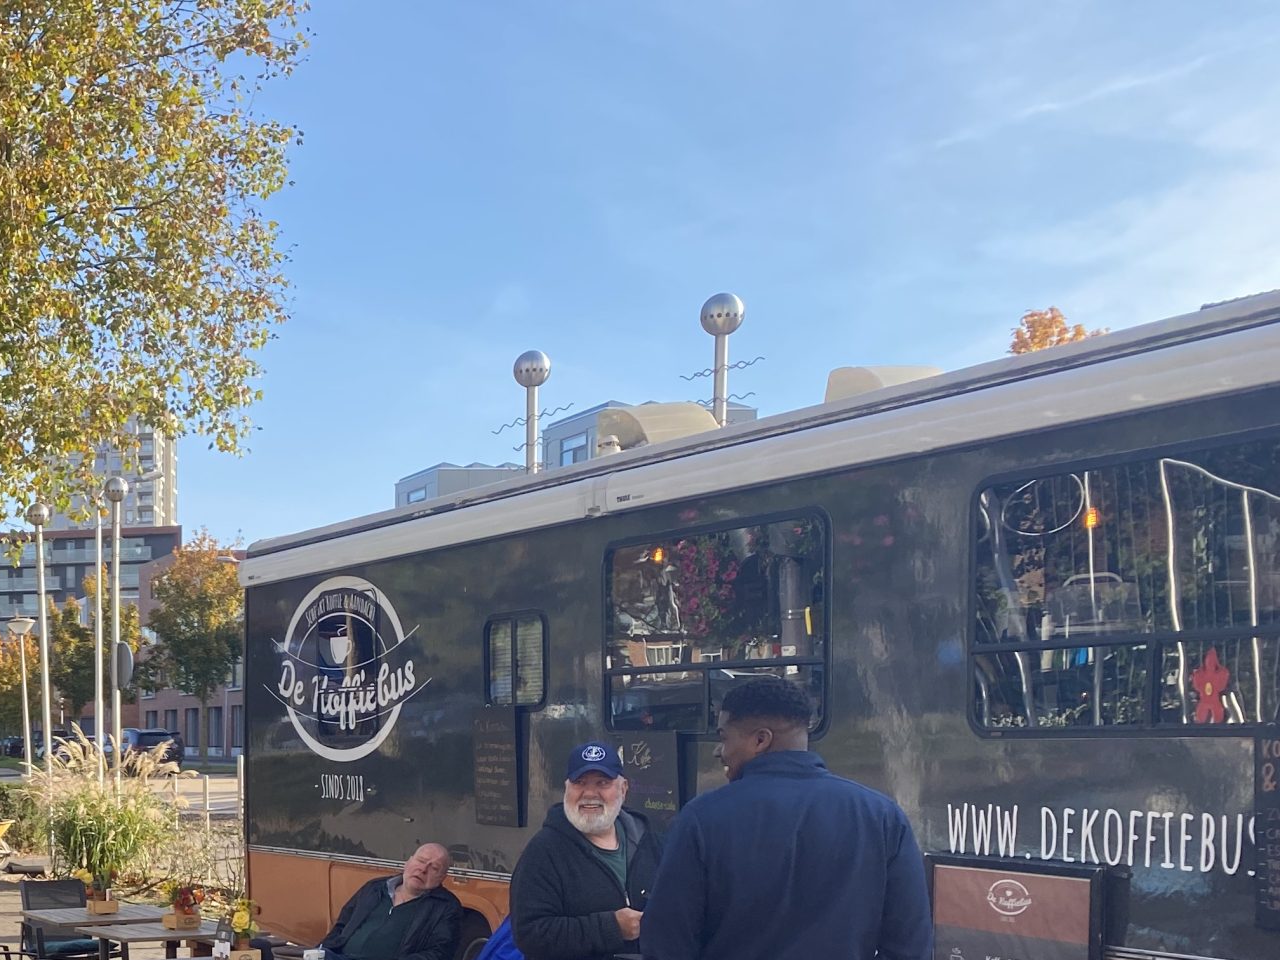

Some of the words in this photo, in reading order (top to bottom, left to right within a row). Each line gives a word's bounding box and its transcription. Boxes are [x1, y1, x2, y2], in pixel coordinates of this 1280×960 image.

[277, 660, 305, 705] De
[312, 660, 416, 730] Koffiebus
[321, 774, 344, 800] SINDS
[346, 774, 364, 802] 2018
